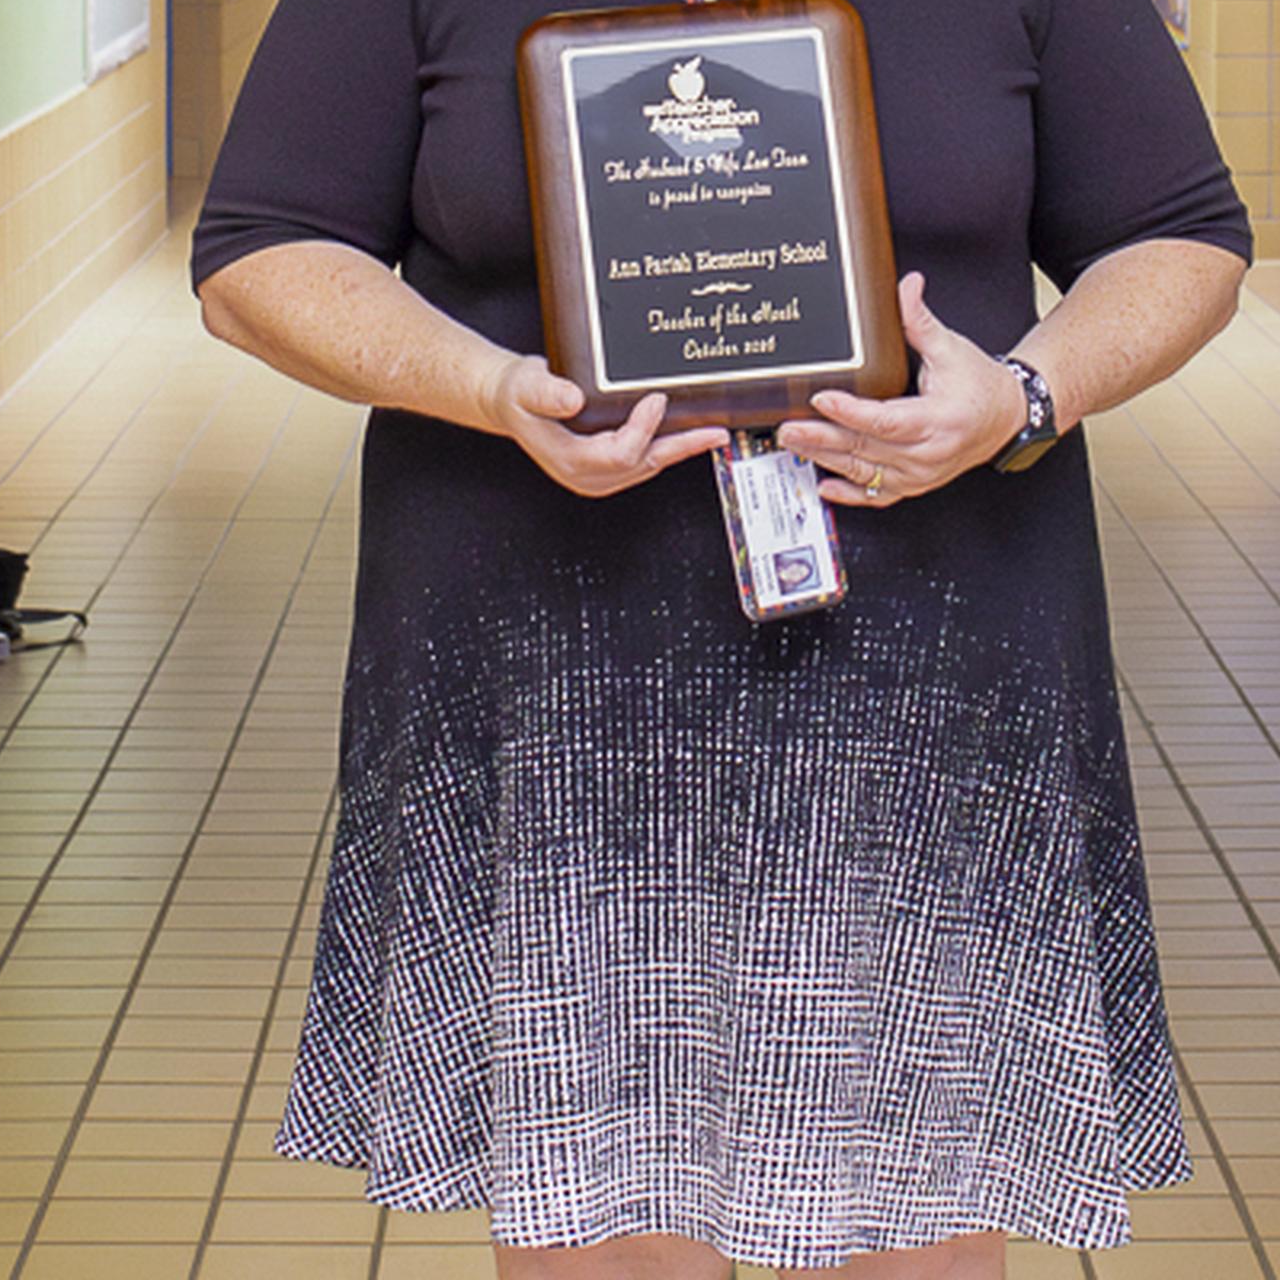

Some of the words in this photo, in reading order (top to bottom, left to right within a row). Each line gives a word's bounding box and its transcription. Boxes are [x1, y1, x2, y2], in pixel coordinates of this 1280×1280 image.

[604, 161, 632, 183] The
[634, 156, 690, 180] Husband
[707, 149, 740, 179] Wife
[772, 147, 810, 168] Team
[648, 190, 661, 206] is
[663, 182, 698, 211] proud
[701, 184, 714, 201] to
[608, 258, 641, 279] Ann
[643, 252, 692, 276] Parish
[694, 248, 777, 271] Elementary
[780, 239, 828, 265] School
[648, 306, 705, 333] Teacher
[709, 303, 725, 334] of
[726, 302, 748, 325] the
[751, 297, 801, 325] Month
[683, 336, 740, 361] October
